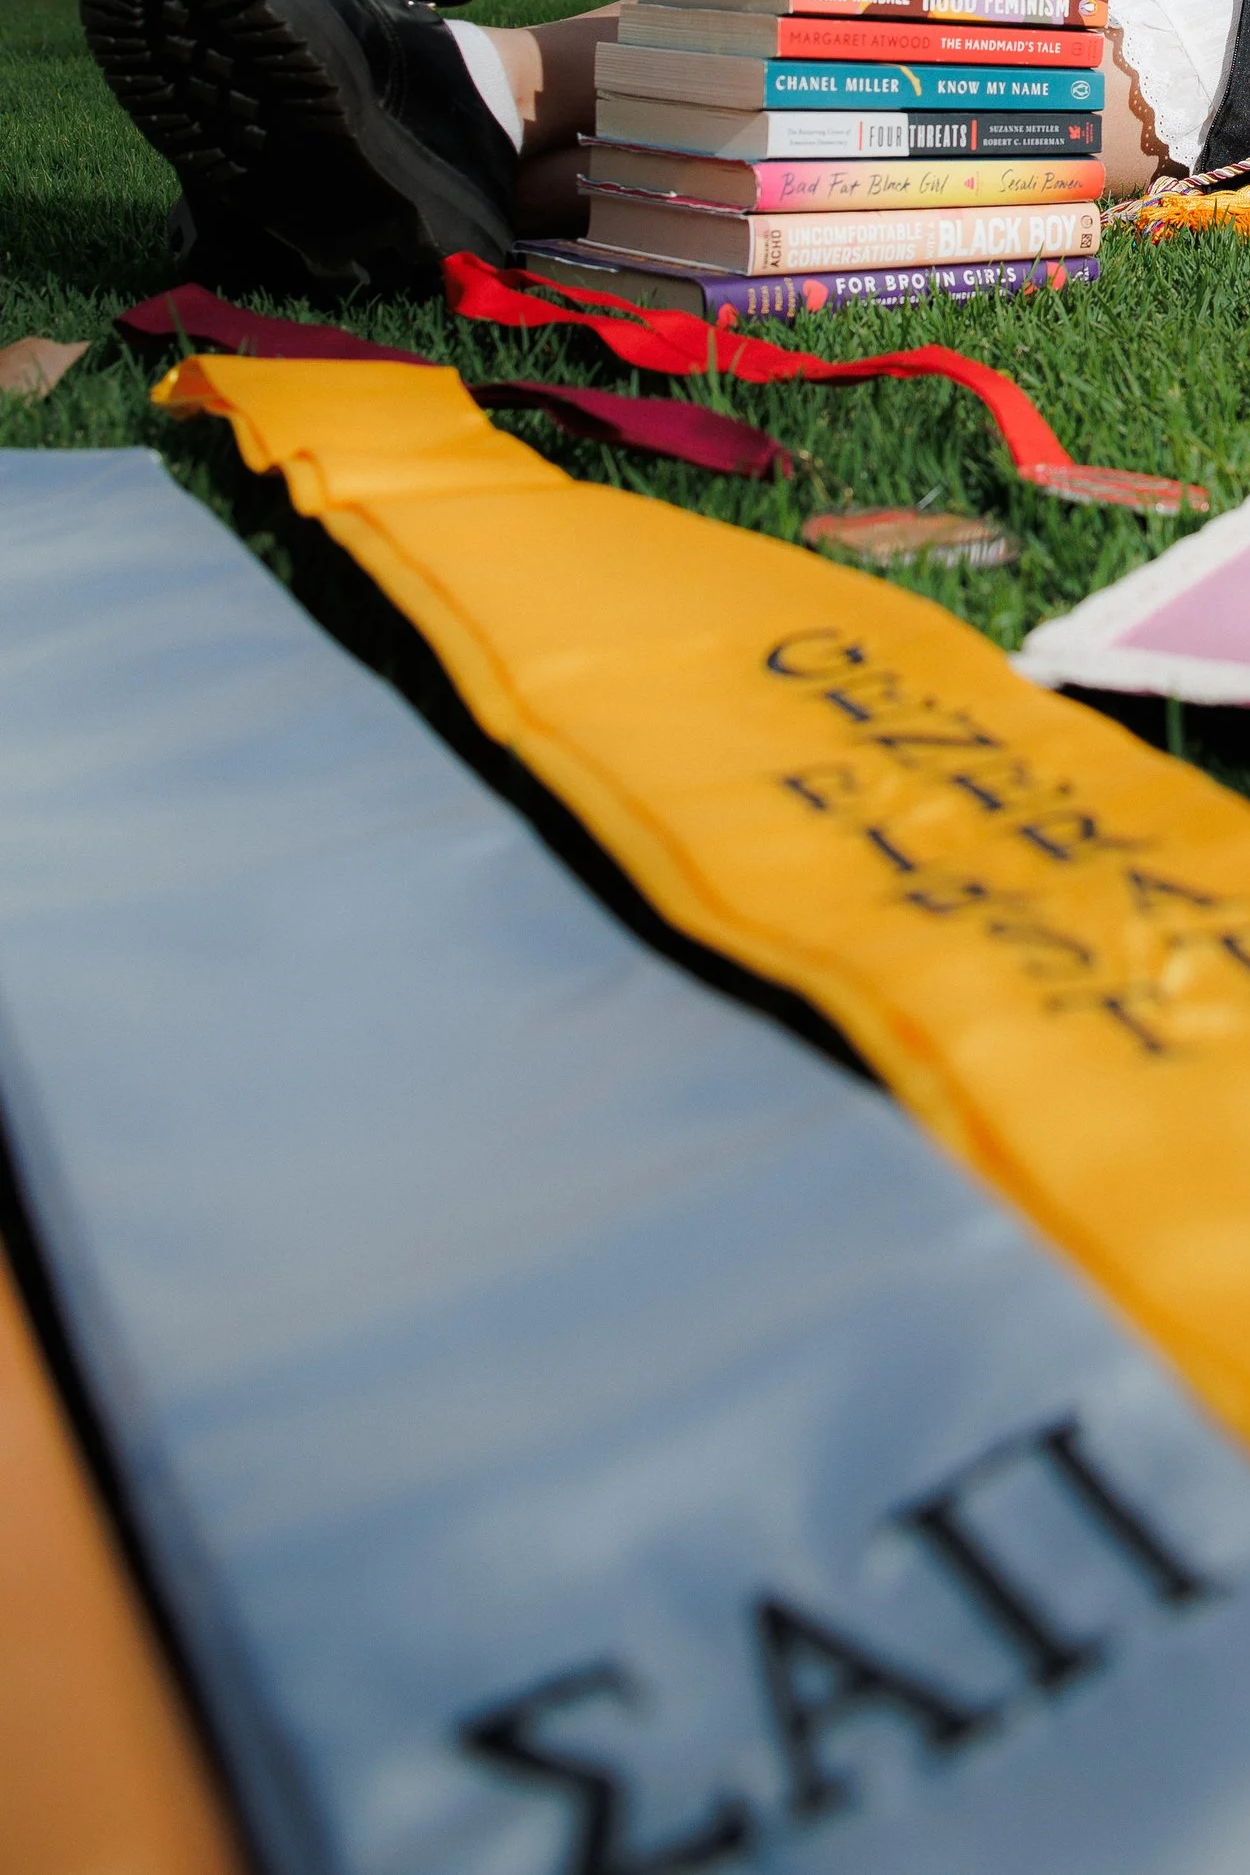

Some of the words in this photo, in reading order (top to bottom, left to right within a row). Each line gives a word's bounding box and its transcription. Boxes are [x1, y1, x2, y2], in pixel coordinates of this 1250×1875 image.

[789, 31, 868, 48] MARGARET
[870, 35, 932, 50] ATWOOD
[940, 37, 963, 50] THE
[964, 37, 1036, 53] HANDMAID'S
[1037, 41, 1061, 54] TALE
[775, 75, 838, 92] CHANEL
[845, 77, 900, 93] MILLER
[937, 80, 981, 95] KNOW
[986, 81, 1006, 96] MY
[1011, 82, 1049, 96] NAME
[869, 125, 903, 148] FOUR
[908, 124, 968, 149] THREATS
[989, 124, 1022, 134] SUZANNE
[1024, 124, 1060, 133] METTLER
[983, 137, 1012, 147] ROBERT
[1013, 137, 1021, 147] C.
[1022, 137, 1066, 147] LIEBERMAN
[779, 172, 821, 202] Bad
[827, 172, 861, 199] Fat
[867, 174, 911, 196] Black
[919, 171, 950, 194] Girl
[1000, 168, 1039, 193] Sesali
[1041, 172, 1083, 193] Bowen
[787, 222, 923, 247] UNCOMFORTABLE
[938, 216, 1022, 259] BLACK
[1029, 213, 1078, 253] BOY
[770, 229, 782, 268] ACHO
[787, 243, 916, 268] CONVERSATIONS
[836, 274, 876, 295] FOR
[963, 267, 1017, 286] GIRLS
